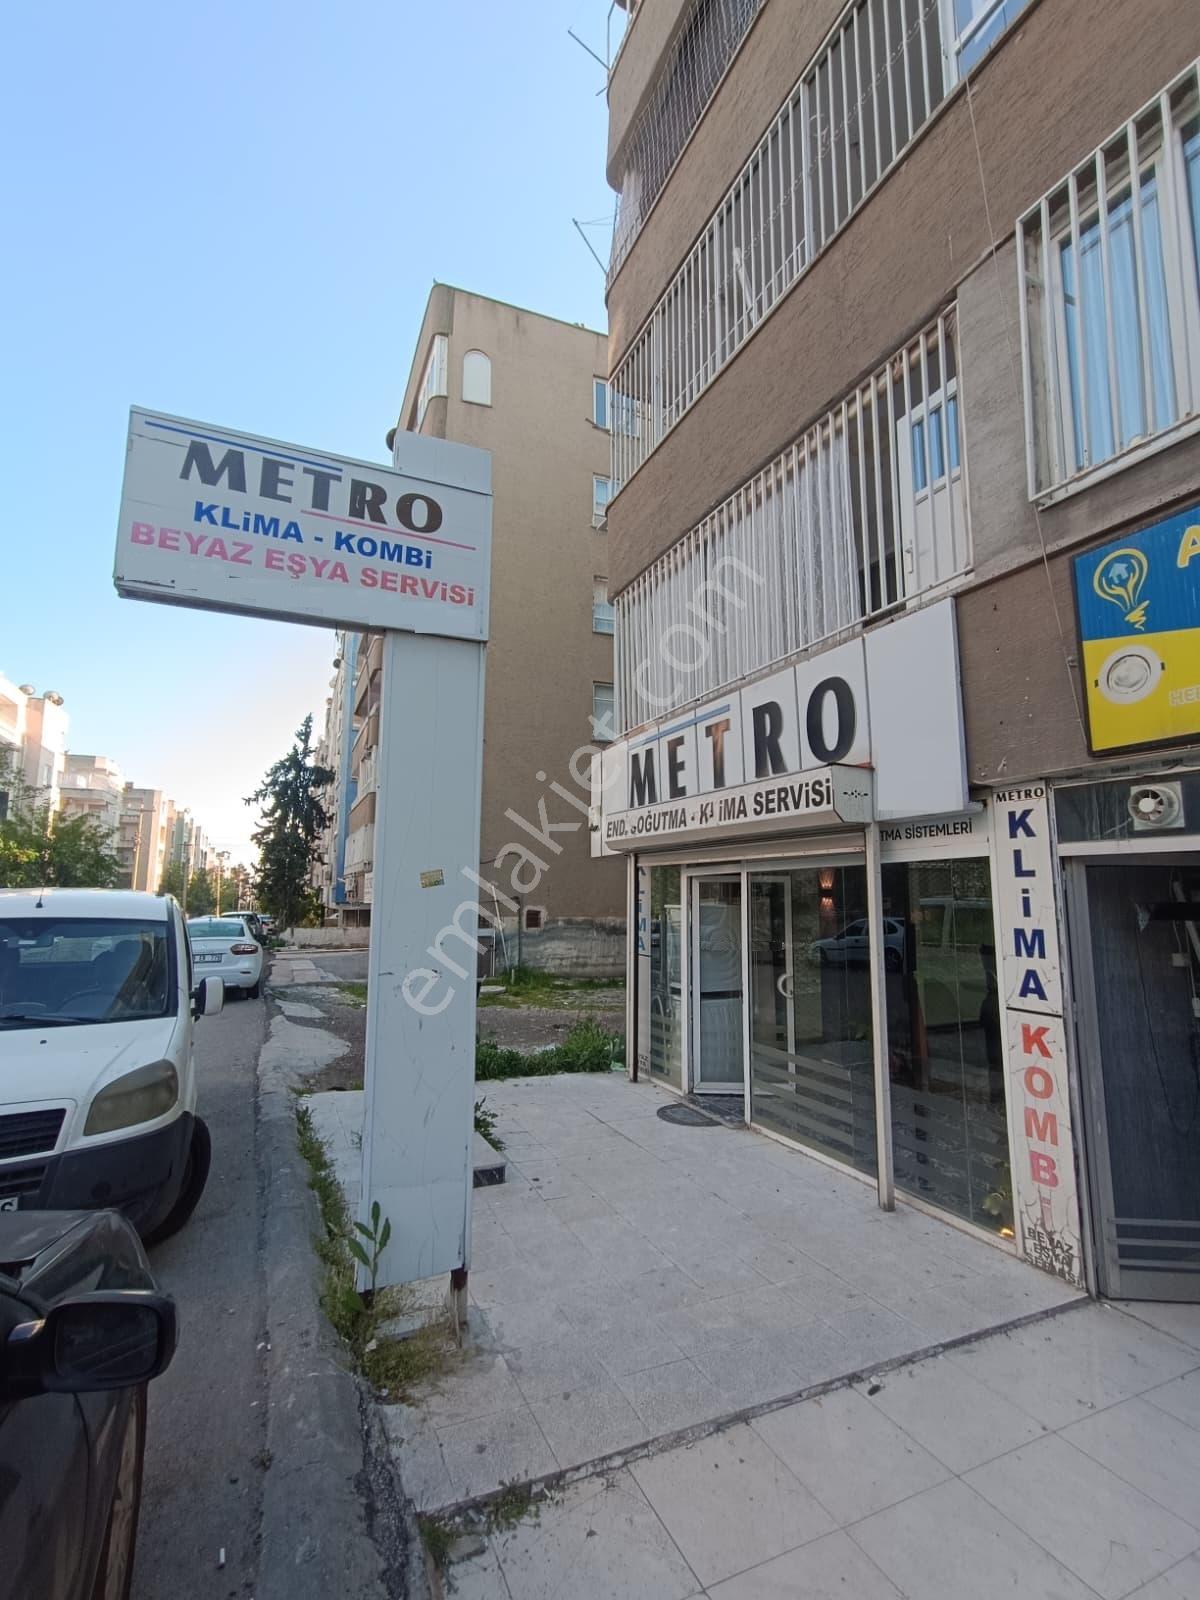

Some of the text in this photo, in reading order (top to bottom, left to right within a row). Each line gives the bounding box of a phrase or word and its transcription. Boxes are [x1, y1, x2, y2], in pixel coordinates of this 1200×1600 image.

[180, 439, 443, 534] METRO
[130, 521, 254, 566] BEYAZ
[264, 547, 350, 584] EŞYA
[630, 676, 856, 809] METRO
[996, 787, 1044, 803] METRO
[904, 817, 973, 840] SİSTEMLERİ
